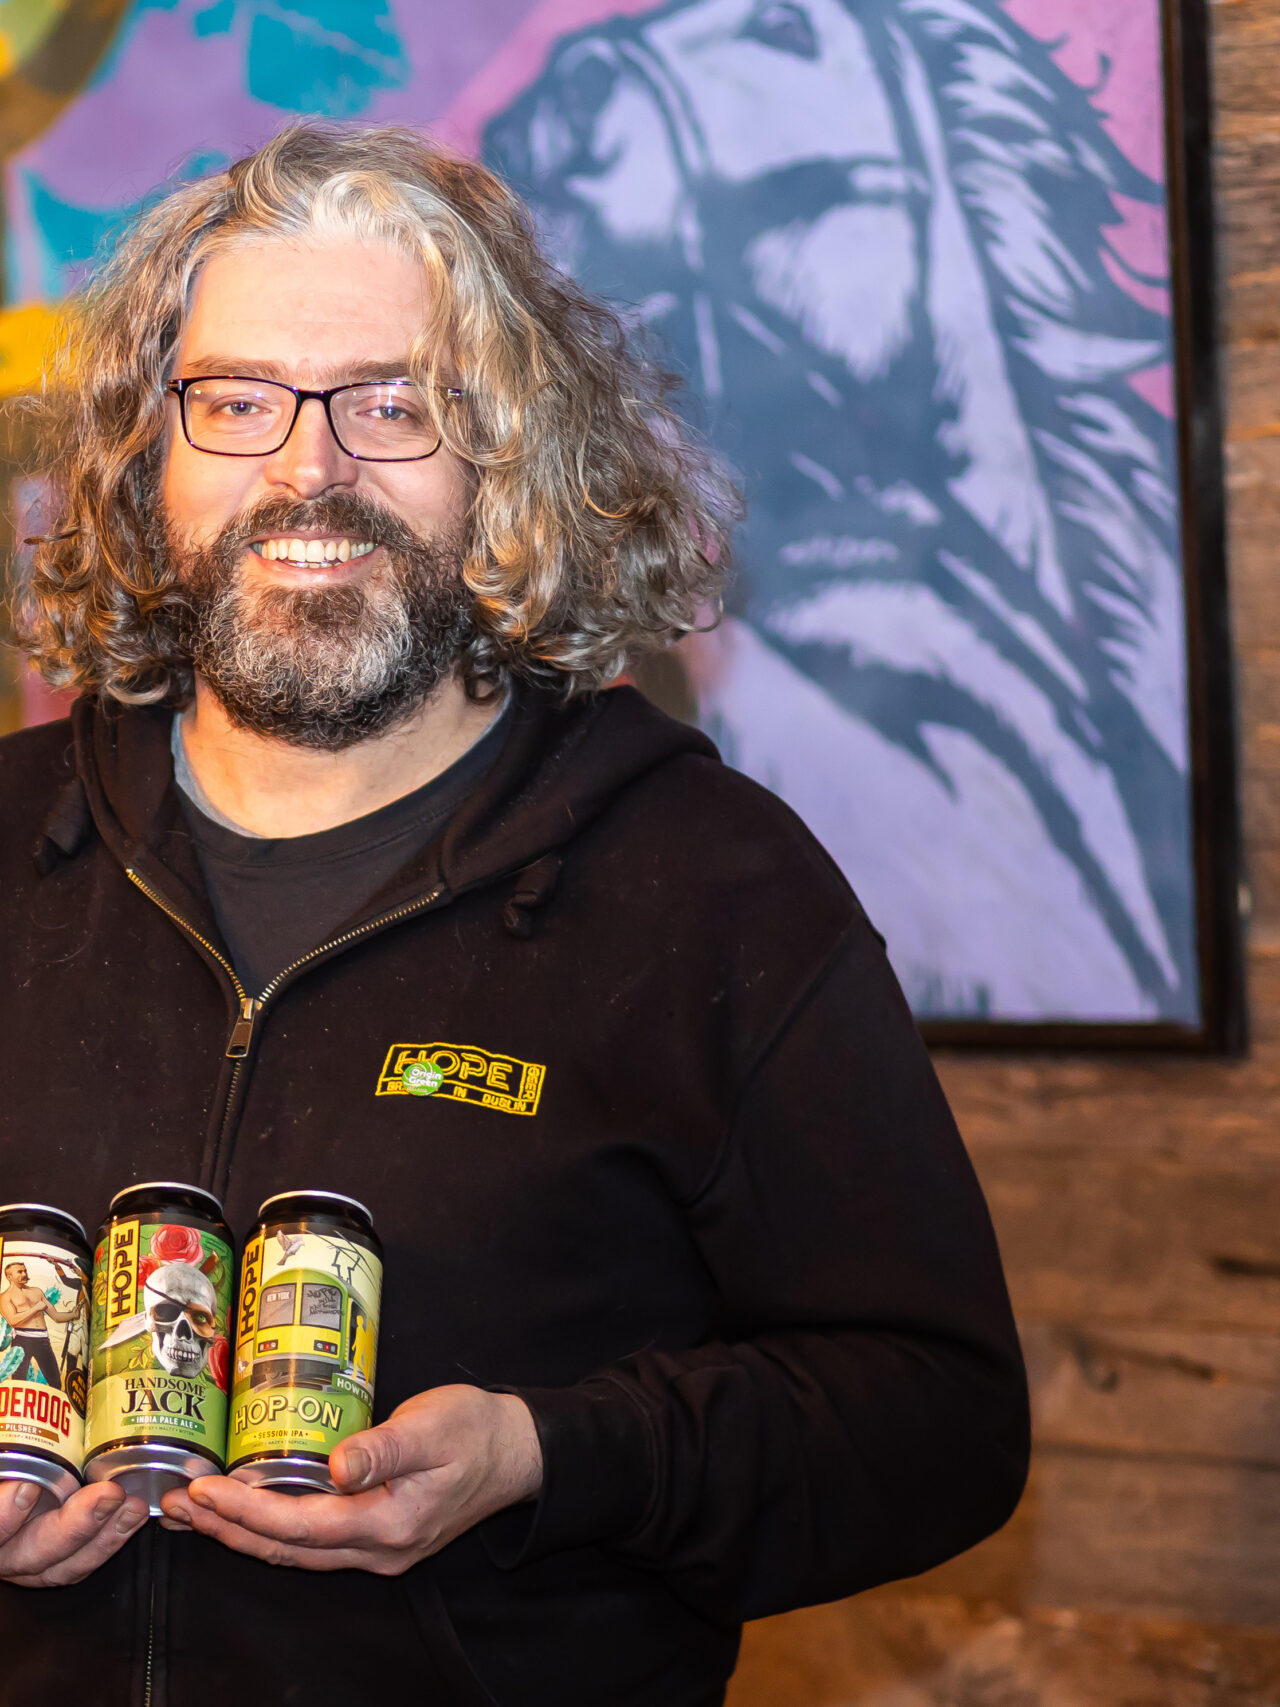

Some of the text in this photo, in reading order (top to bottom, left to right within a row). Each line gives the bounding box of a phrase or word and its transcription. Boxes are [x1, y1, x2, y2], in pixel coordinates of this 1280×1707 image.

[393, 1049, 513, 1092] HOPE
[408, 1076, 438, 1087] Green
[411, 1067, 442, 1080] Origin
[523, 1066, 540, 1100] BEER
[453, 1086, 527, 1112] IN DUBLIN
[110, 1229, 134, 1319] HOPE
[240, 1244, 260, 1338] HOPE
[124, 1377, 206, 1398] HANDSOME
[336, 1377, 369, 1401] HOWTH
[121, 1389, 206, 1422] JACK
[235, 1394, 343, 1436] HOP-ON
[5, 1423, 38, 1434] PILSNER
[136, 1415, 194, 1429] INDIA PALE ALE
[257, 1429, 304, 1439] SESSION IPA
